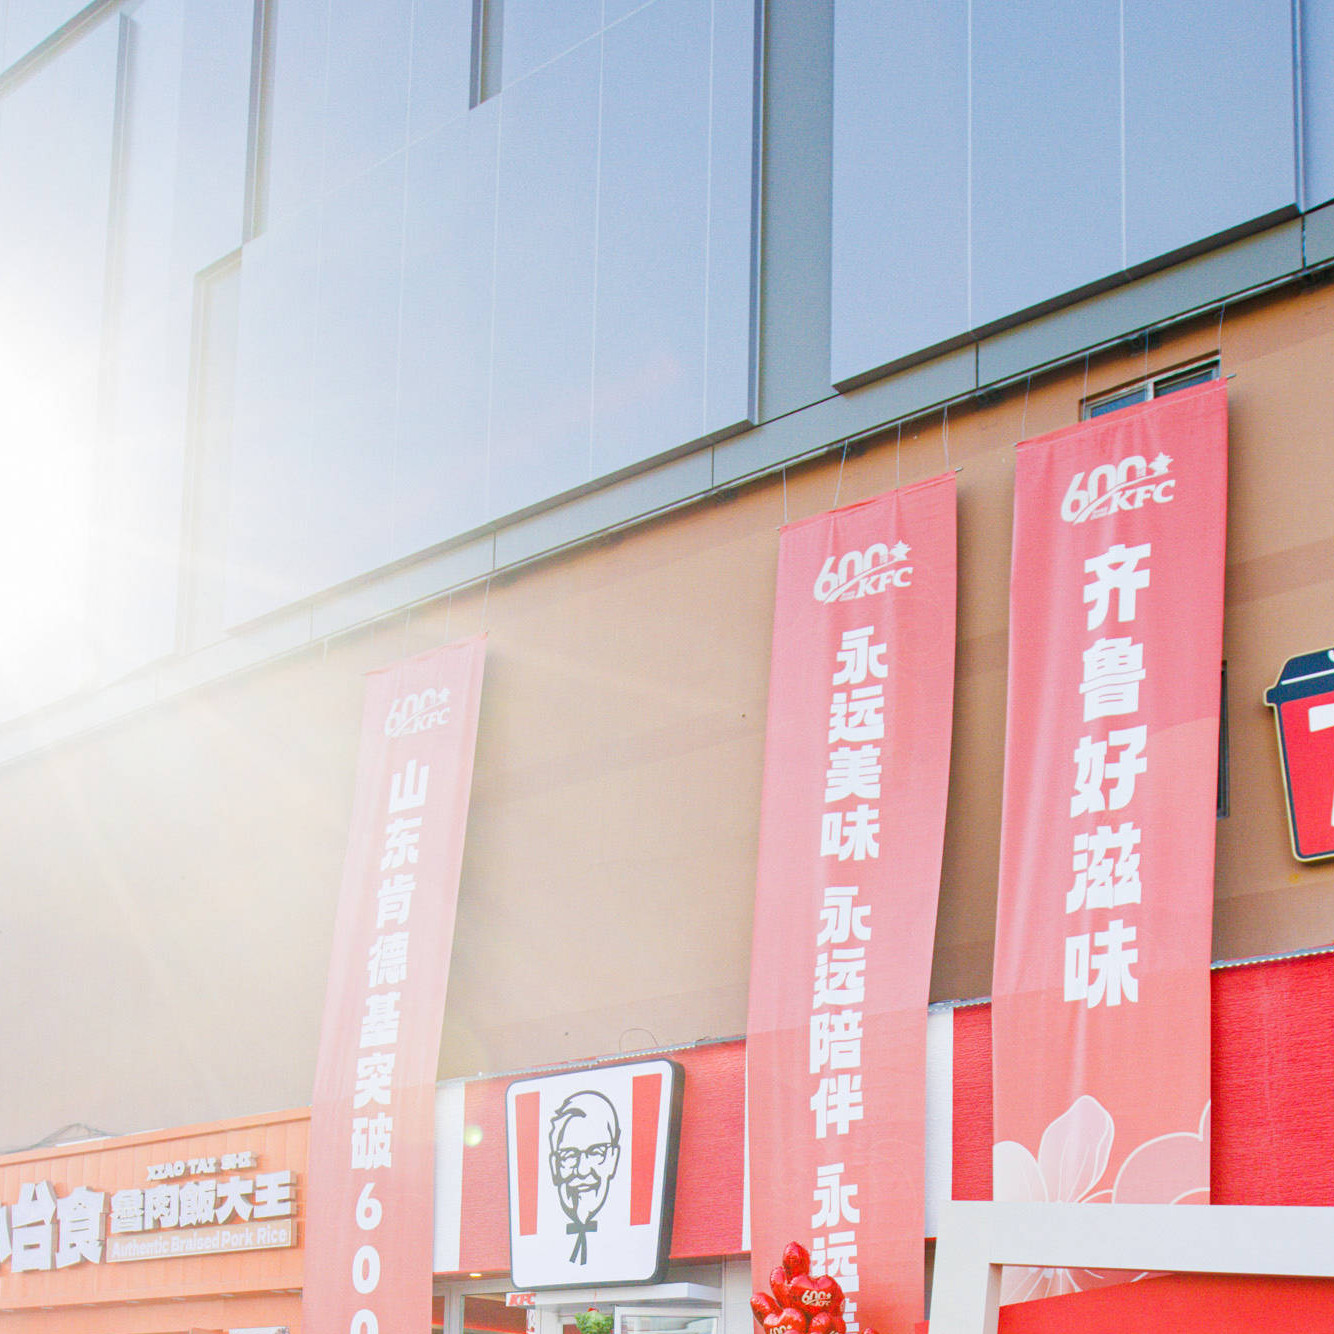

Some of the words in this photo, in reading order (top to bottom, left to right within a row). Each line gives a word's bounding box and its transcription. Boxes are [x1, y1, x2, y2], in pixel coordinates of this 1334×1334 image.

[1108, 479, 1176, 515] KFC
[855, 566, 914, 599] KFC
[820, 624, 889, 862] 永远美味
[1063, 543, 1151, 1007] 齐鲁好滋味
[810, 884, 871, 1139] 永远陪伴
[147, 1159, 186, 1181] XIAO
[112, 1236, 171, 1258] Authentic
[171, 1230, 220, 1252] Braised
[221, 1227, 254, 1247] Pork
[257, 1226, 288, 1244] Rice
[509, 1294, 536, 1305] KFC
